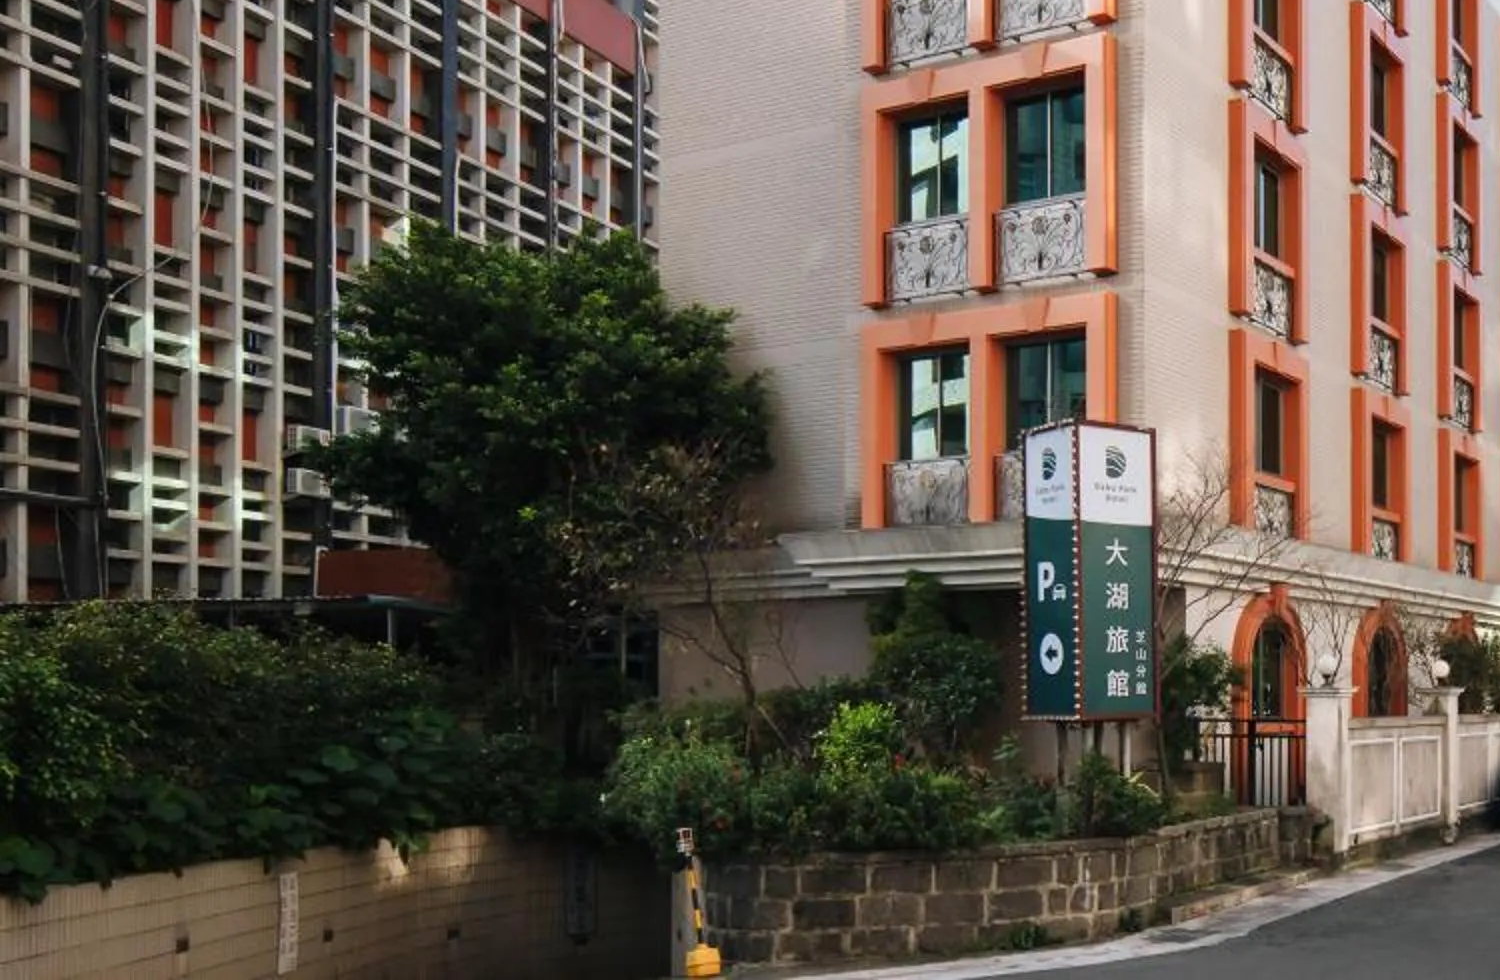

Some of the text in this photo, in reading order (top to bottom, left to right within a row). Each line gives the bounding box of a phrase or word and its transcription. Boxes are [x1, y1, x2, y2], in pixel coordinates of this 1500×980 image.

[1037, 561, 1055, 602] P
[1105, 538, 1130, 697] 大湖旅館
[1135, 630, 1147, 695] 芝山分館
